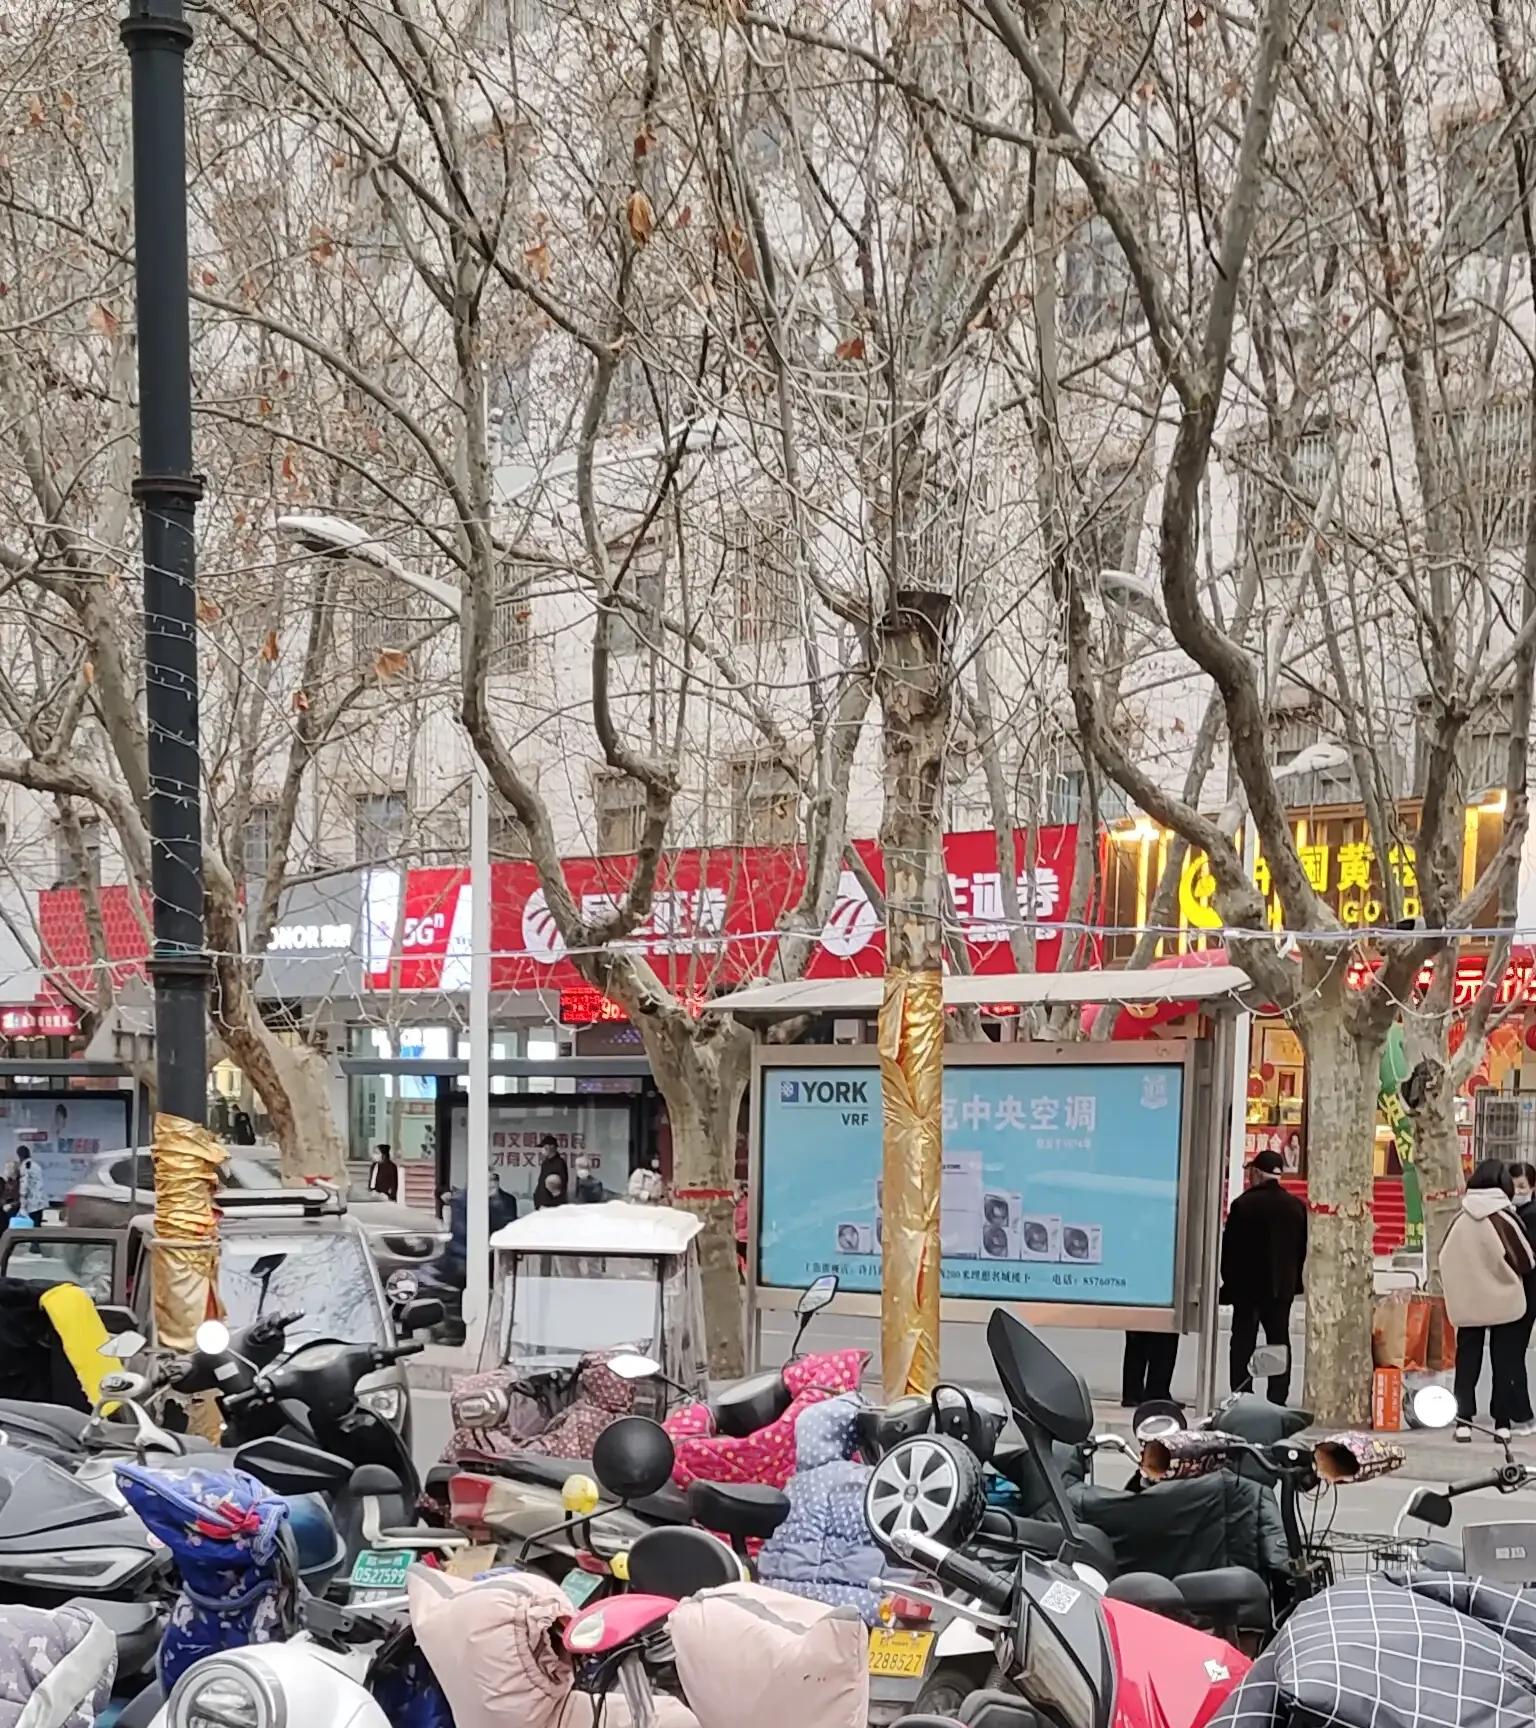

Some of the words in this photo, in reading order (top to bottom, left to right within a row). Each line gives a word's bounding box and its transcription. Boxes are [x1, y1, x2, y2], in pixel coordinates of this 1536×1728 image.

[1342, 897, 1418, 923] GOD
[801, 1080, 869, 1104] YORK
[841, 1112, 869, 1127] VRF
